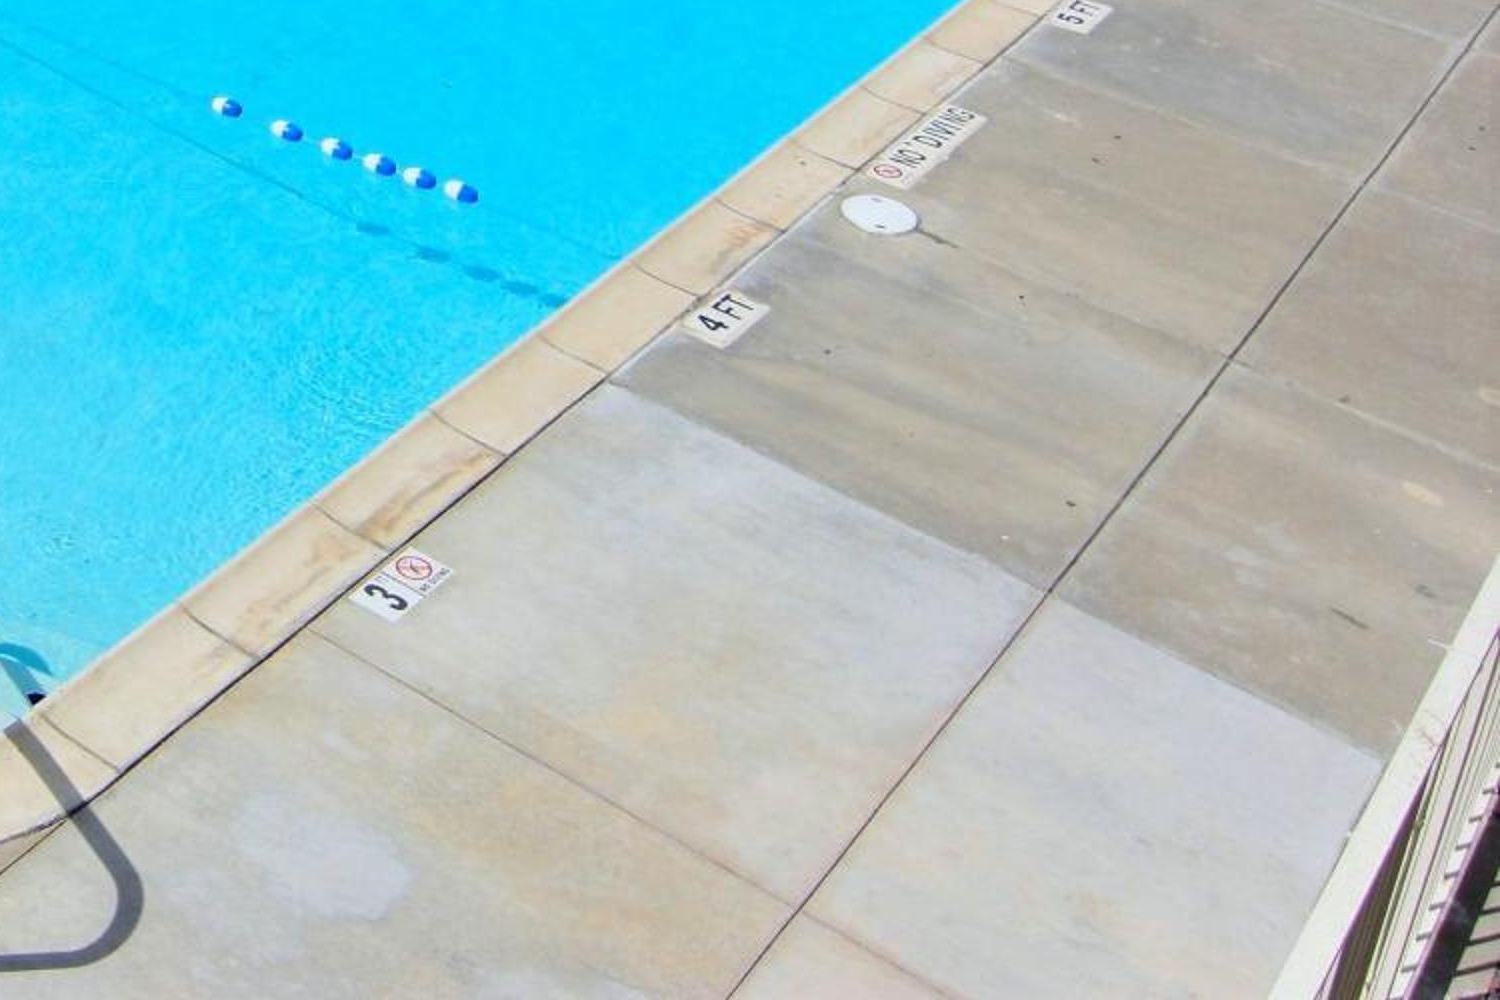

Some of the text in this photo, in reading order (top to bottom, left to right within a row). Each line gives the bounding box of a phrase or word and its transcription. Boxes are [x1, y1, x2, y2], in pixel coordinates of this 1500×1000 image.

[888, 106, 977, 169] NO DIVING
[363, 583, 409, 611] 3
